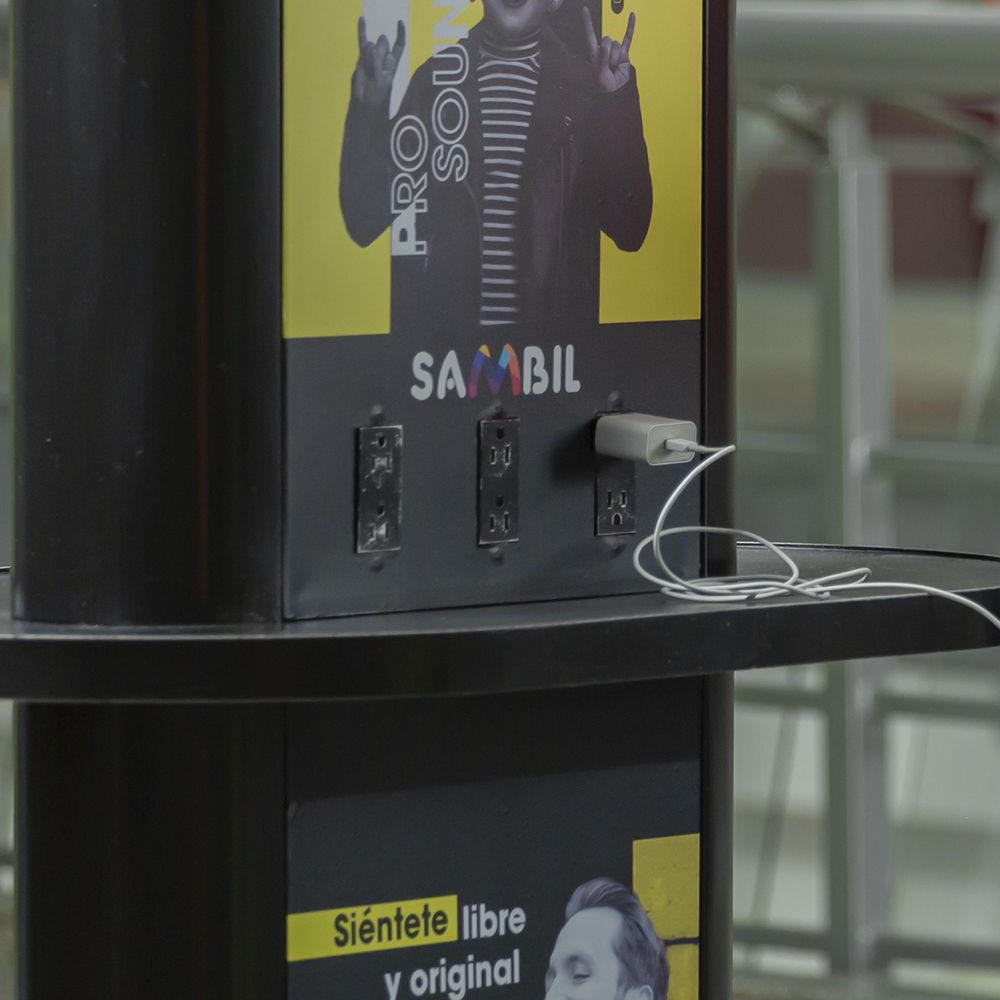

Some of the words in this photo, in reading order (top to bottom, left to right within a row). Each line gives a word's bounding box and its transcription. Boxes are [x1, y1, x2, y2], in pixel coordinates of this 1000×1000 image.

[390, 114, 429, 257] PRO
[410, 343, 581, 400] SAMBIL
[334, 903, 449, 948] Siéntete
[462, 903, 527, 941] libre
[383, 971, 402, 1000] y
[409, 948, 521, 1000] original
